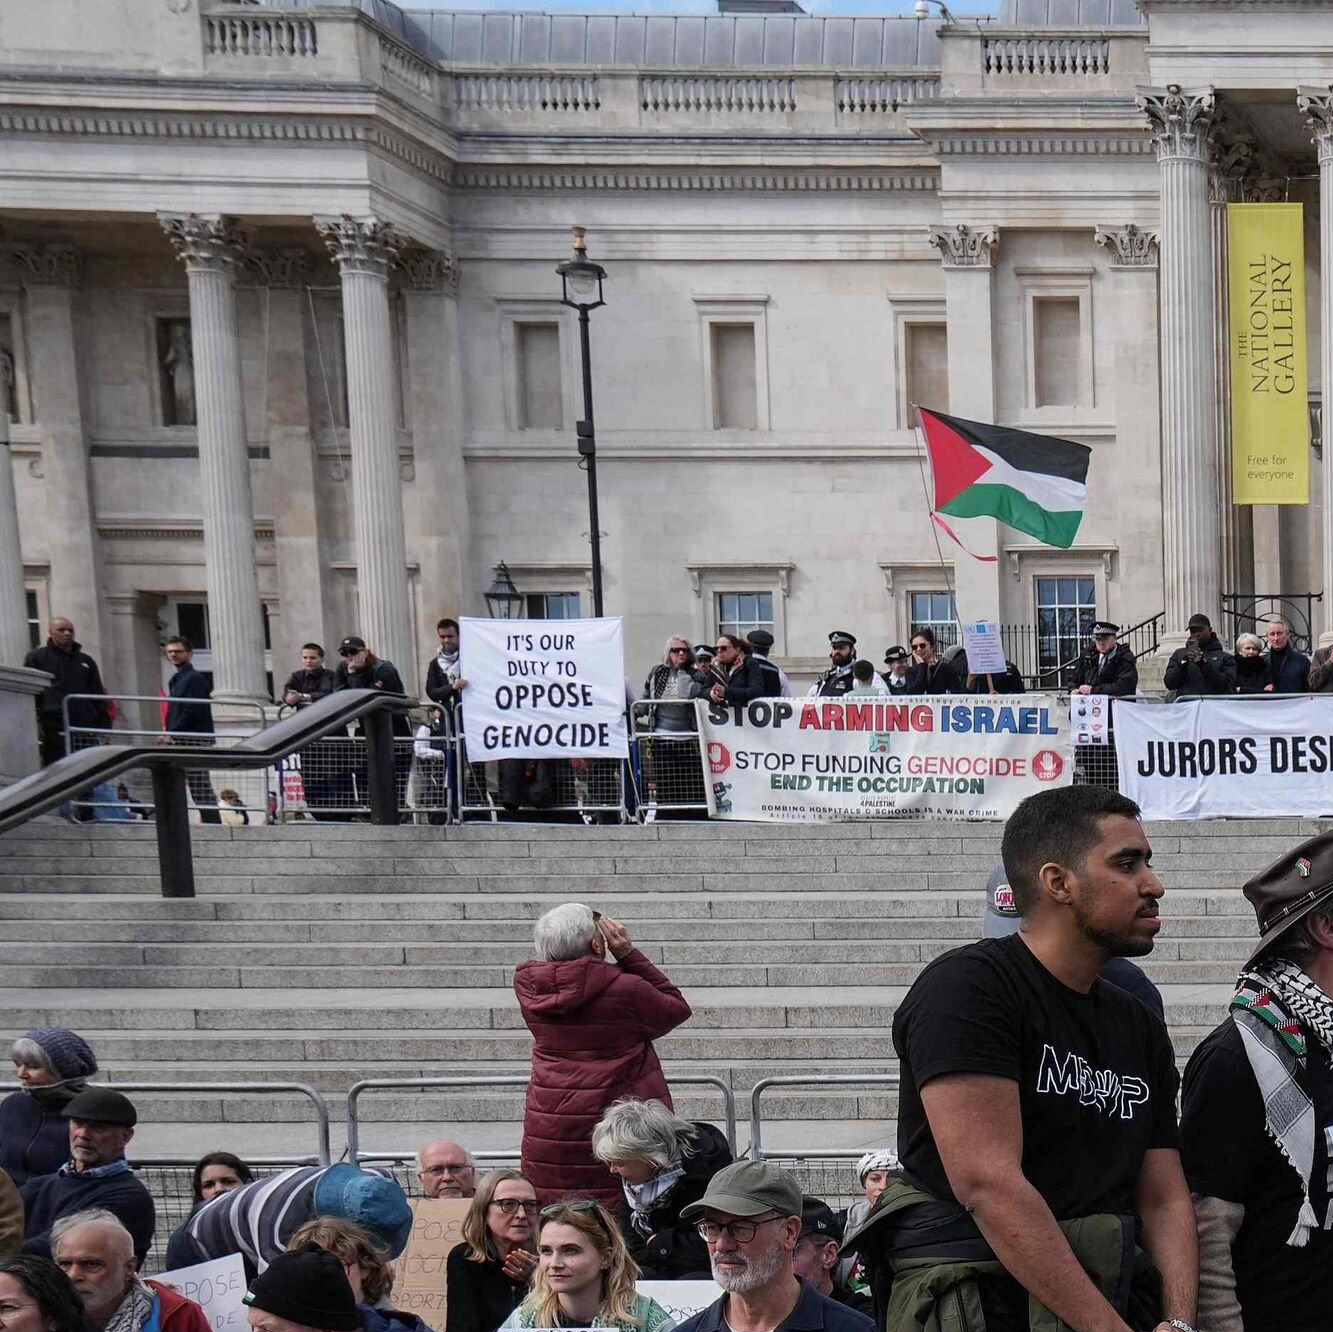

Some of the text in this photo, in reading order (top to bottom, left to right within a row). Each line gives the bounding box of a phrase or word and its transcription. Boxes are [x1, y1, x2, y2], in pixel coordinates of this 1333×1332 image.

[1249, 254, 1269, 393] NATIONAL
[1271, 255, 1296, 394] GALLERY
[1238, 331, 1248, 359] THE
[1247, 455, 1287, 465] Free for
[1247, 470, 1294, 481] everyone
[507, 635, 575, 651] IT'S OUR
[508, 661, 577, 677] DUTY TO
[495, 683, 593, 710] OPPOSE
[708, 702, 1058, 735] STOP ARMING ISRAEL
[483, 723, 610, 750] GENOCIDE
[736, 751, 1026, 777] STOP FUNDING GENOCIDE
[1137, 737, 1257, 778] JURORS
[771, 774, 984, 794] END THE OCCUPATION
[761, 804, 805, 812] BOMBING
[809, 806, 861, 815] HOSPITALS
